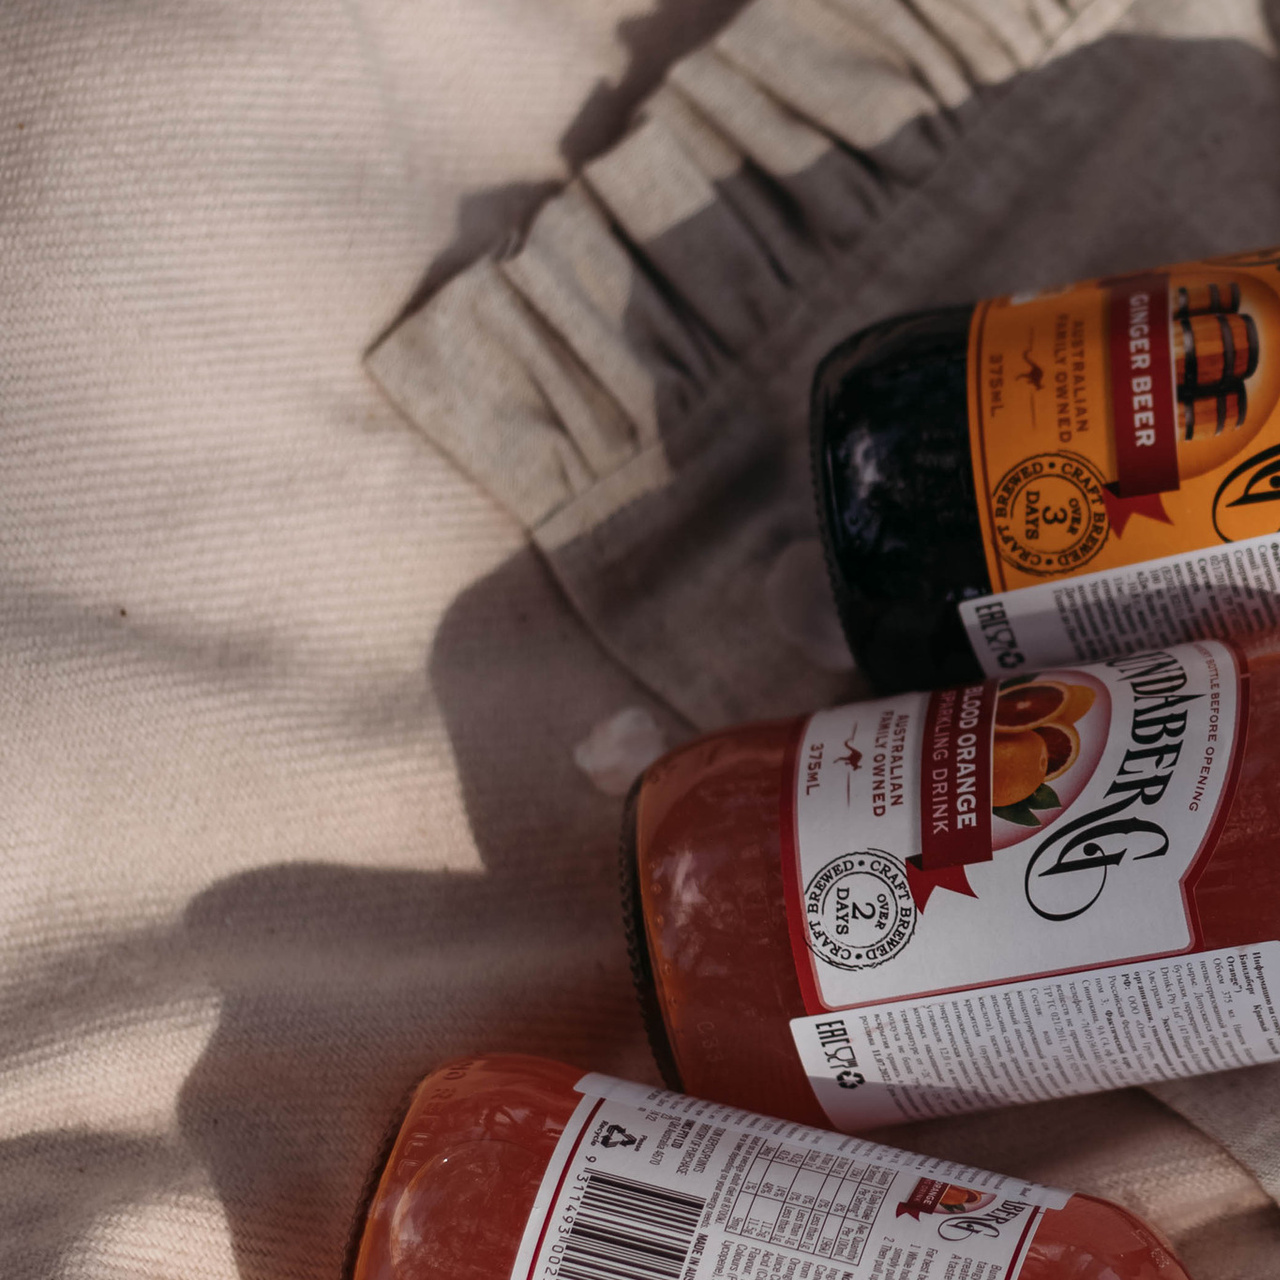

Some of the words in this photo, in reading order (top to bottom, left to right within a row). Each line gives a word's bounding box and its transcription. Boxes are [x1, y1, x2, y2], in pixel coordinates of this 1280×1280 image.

[1054, 312, 1067, 365] FAMILY
[1129, 292, 1151, 369] GINGER
[1072, 319, 1088, 432] AUSTRALIAN
[1054, 370, 1072, 444] OWNED
[1131, 375, 1155, 447] BEER
[995, 462, 1042, 517] BREWED
[1061, 463, 1103, 504] CRAFT
[1025, 490, 1038, 539] DAYS
[1042, 506, 1067, 525] 3
[1067, 498, 1080, 534] OVER
[997, 525, 1041, 565] CRAFT
[1057, 512, 1104, 565] BREWED
[1204, 659, 1220, 690] BOTTLE
[932, 690, 955, 760] SPARKLING
[960, 685, 982, 729] BLOOD
[1207, 692, 1219, 742] BEFORE
[874, 710, 893, 748] FAMILY
[891, 713, 909, 806] AUSTRALIAN
[872, 753, 886, 817] OWNED
[957, 732, 977, 829] ORANGE
[1025, 651, 1206, 920] UNDABERG
[1188, 747, 1214, 812] OPENING
[932, 768, 949, 834] DRINK
[807, 860, 853, 913] BREWED
[870, 860, 909, 900] CRAFT
[835, 887, 849, 934] DAYS
[851, 902, 875, 919] 2
[874, 893, 889, 929] OVER
[809, 921, 851, 960] CRAFT
[866, 907, 911, 959] BREWED
[1043, 985, 1053, 997] ТР
[1108, 975, 1125, 1018] Российская
[1121, 973, 1131, 990] РФ:
[1128, 995, 1140, 1015] ООО
[1133, 971, 1154, 1023] организация,
[1160, 966, 1173, 992] Drinks
[1167, 993, 1176, 1004] Pty
[1172, 964, 1187, 1000] бутылки,
[1199, 960, 1226, 1029] непастеризованный
[1213, 958, 1225, 984] Объем
[1221, 991, 1233, 1004] 375
[1238, 954, 1255, 994] Бандаберг
[1252, 1004, 1270, 1032] Красный
[1252, 952, 1272, 1006] Информацию
[1268, 1006, 1275, 1014] на
[963, 998, 981, 1038] красители
[978, 996, 994, 1032] кислота),
[990, 994, 1007, 1035] апельсина,
[1002, 992, 1019, 1025] красный
[1046, 998, 1056, 1010] ТС
[1055, 984, 1069, 1016] веществ
[1066, 1018, 1074, 1027] не
[814, 1019, 850, 1048] EAC
[874, 1014, 890, 1049] вскрытия
[886, 1012, 901, 1042] воздуха
[897, 1045, 905, 1054] не
[900, 1009, 920, 1055] температуре
[912, 1007, 927, 1039] которых
[938, 1003, 962, 1058] энергетическая
[1016, 990, 1046, 1060] концентрированный
[1042, 1030, 1053, 1046] вода
[1105, 1010, 1126, 1054] Фактический
[590, 1120, 608, 1146] Recycle
[634, 1134, 648, 1152] Please
[656, 1127, 675, 1150] Australia
[671, 1138, 684, 1149] LTD
[676, 1129, 690, 1140] PTY
[690, 1140, 702, 1148] OF
[585, 1155, 597, 1163] 9
[649, 1150, 664, 1166] 4670
[676, 1146, 698, 1176] PURCHASE
[693, 1136, 720, 1173] DEPOTS/POINTS
[558, 1174, 589, 1235] 311493
[810, 1212, 824, 1227] Less
[691, 1233, 708, 1256] MADE
[798, 1238, 814, 1250] 1g
[805, 1226, 819, 1241] than
[833, 1235, 850, 1257] 100mL
[841, 1224, 854, 1238] Per
[845, 1236, 864, 1262] Quantity
[688, 1256, 700, 1266] IN
[729, 1243, 748, 1272] Colours
[760, 1250, 774, 1268] Acid
[772, 1253, 788, 1273] Juice
[799, 1260, 814, 1279] from
[872, 1259, 884, 1274] pull
[877, 1244, 893, 1260] Then
[887, 1245, 904, 1269] simply
[903, 1251, 919, 1269] While
[920, 1258, 934, 1274] best
[925, 1247, 938, 1259] For
[944, 1260, 960, 1280] taste
[958, 1257, 973, 1280] create
